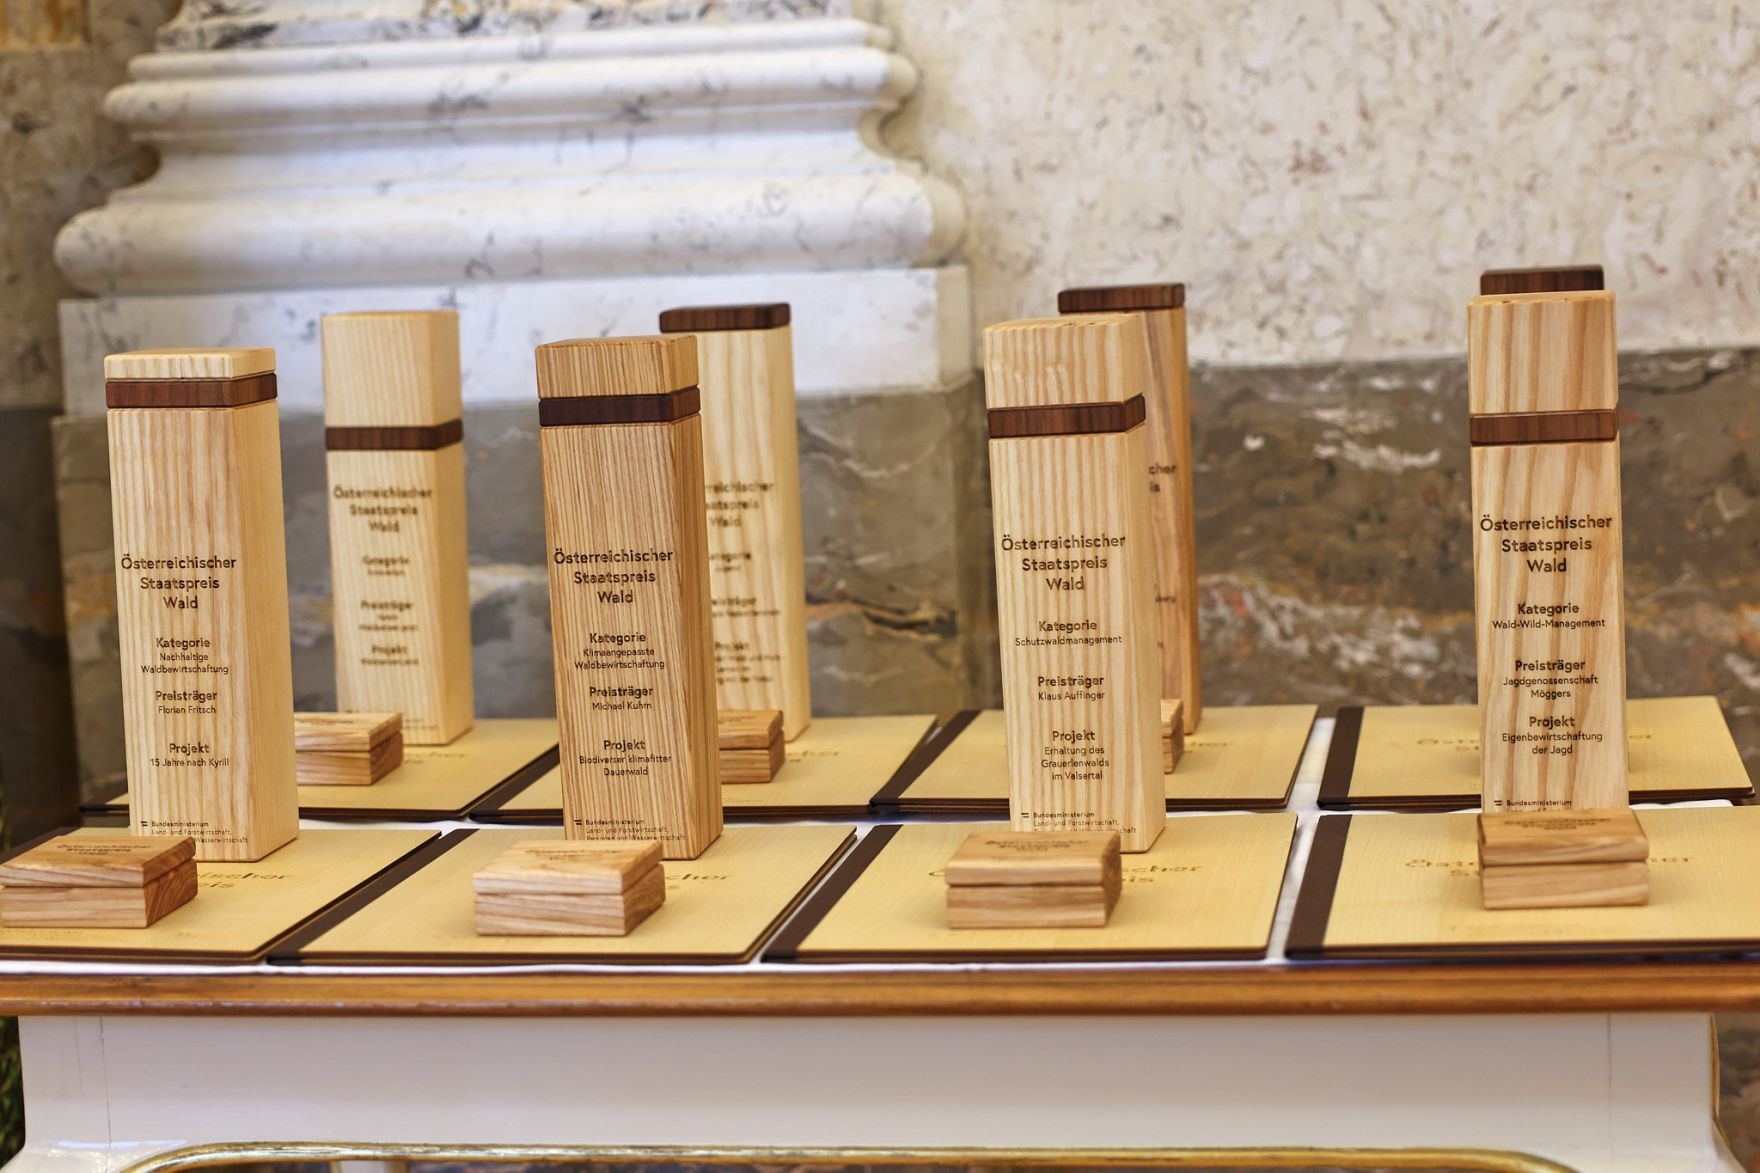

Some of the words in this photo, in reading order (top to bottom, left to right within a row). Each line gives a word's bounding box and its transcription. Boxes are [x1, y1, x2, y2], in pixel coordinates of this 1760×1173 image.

[1480, 514, 1612, 531] Österreichischer
[1001, 533, 1126, 551] Österreichischer
[1501, 537, 1592, 554] Staatspreis
[121, 553, 237, 570] Österreichischer
[554, 548, 674, 564] Österreichischer
[1022, 556, 1108, 572] Staatspreis
[1526, 557, 1567, 573] Wald
[140, 576, 220, 592] Staatspreis
[573, 569, 656, 586] Staatspreis
[1046, 576, 1085, 591] Wald
[162, 596, 199, 609] Wald
[597, 589, 634, 604] Wald
[1517, 602, 1580, 617] Kategorie
[1038, 620, 1097, 634] Kategorie
[1492, 618, 1606, 630] Wald-Wild-Management
[156, 637, 211, 650] Kategorie
[589, 632, 646, 645] Kategorie
[1015, 635, 1122, 646] Schutzwaldmanagement
[159, 653, 209, 663] Nachhaltige
[583, 648, 655, 659] Klimaangepasste
[140, 664, 229, 675] Waldbewirtschaftung
[574, 660, 665, 671] Waldbewirtschaftung
[1515, 659, 1586, 673] Preisträger
[1037, 675, 1104, 689] Preisträger
[1502, 674, 1598, 687] Jagdgenossenschaft
[155, 690, 218, 703] Preisträger
[589, 686, 654, 699] Preisträger
[1038, 691, 1062, 701] Klaus
[1064, 691, 1105, 702] Auffinger
[1530, 688, 1571, 700] Möggers
[158, 705, 186, 714] Florian
[188, 705, 216, 714] Fritsch
[592, 701, 625, 711] Michael
[1529, 715, 1575, 730] Projekt
[1052, 730, 1096, 744] Projekt
[1502, 732, 1603, 744] Eigenbewirtschaftung
[169, 742, 210, 756] Projekt
[603, 739, 646, 753] Projekt
[1044, 746, 1087, 756] Erhaltung
[1088, 746, 1105, 754] des
[1531, 745, 1547, 755] der
[1550, 744, 1573, 756] Jagd
[150, 758, 160, 767] 15
[162, 758, 185, 766] Jahre
[187, 758, 206, 766] nach
[208, 758, 230, 768] Kyrill
[579, 754, 625, 764] Biodiverser
[628, 753, 672, 763] klimafitter
[1041, 759, 1110, 768] Grauerlenwalds
[603, 767, 649, 776] Dauerwald
[1051, 772, 1063, 780] im
[1065, 771, 1103, 780] Valsertal
[1506, 799, 1572, 807] Bundesministerium
[1033, 811, 1095, 819] Bundesministerium
[151, 820, 209, 828] Bundesministerium
